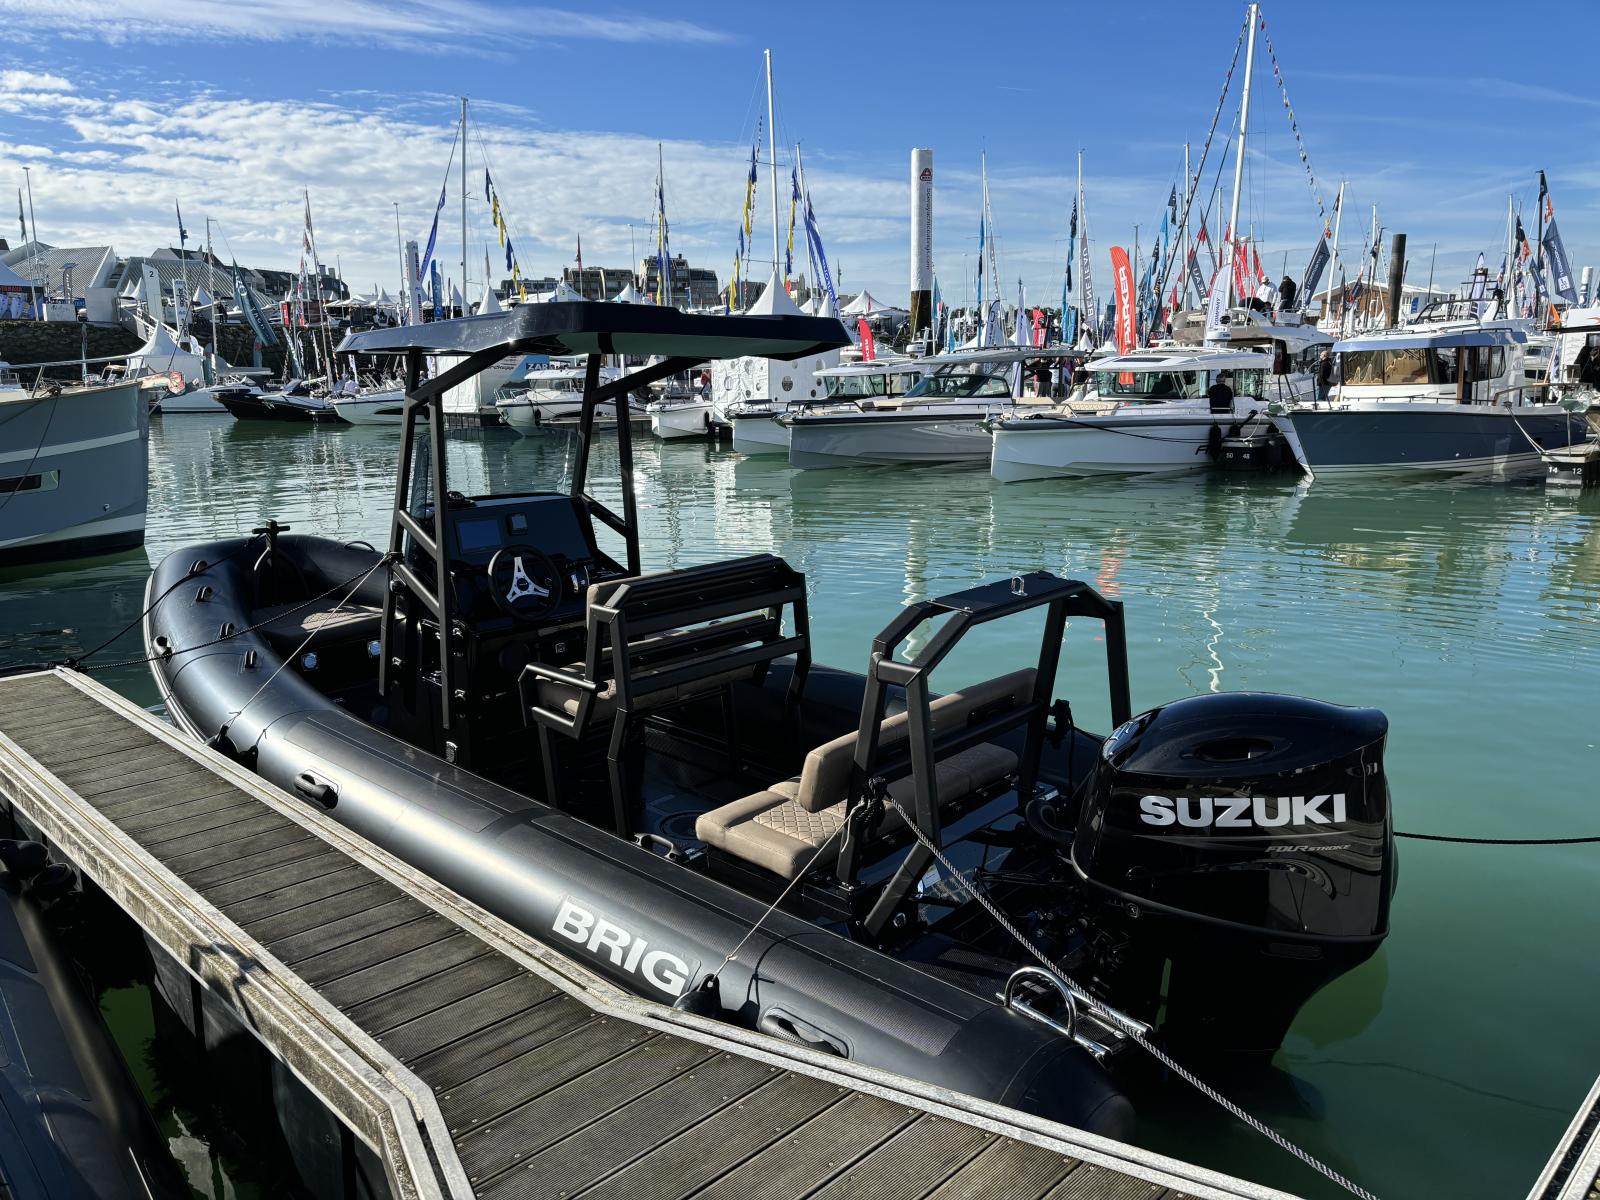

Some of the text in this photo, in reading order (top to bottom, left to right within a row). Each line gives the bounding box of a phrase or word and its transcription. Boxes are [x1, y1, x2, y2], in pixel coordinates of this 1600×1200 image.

[1119, 265, 1131, 344] PARKER
[1548, 466, 1558, 474] 14
[1139, 793, 1347, 828] SUZUKI
[551, 901, 690, 997] BRIG
